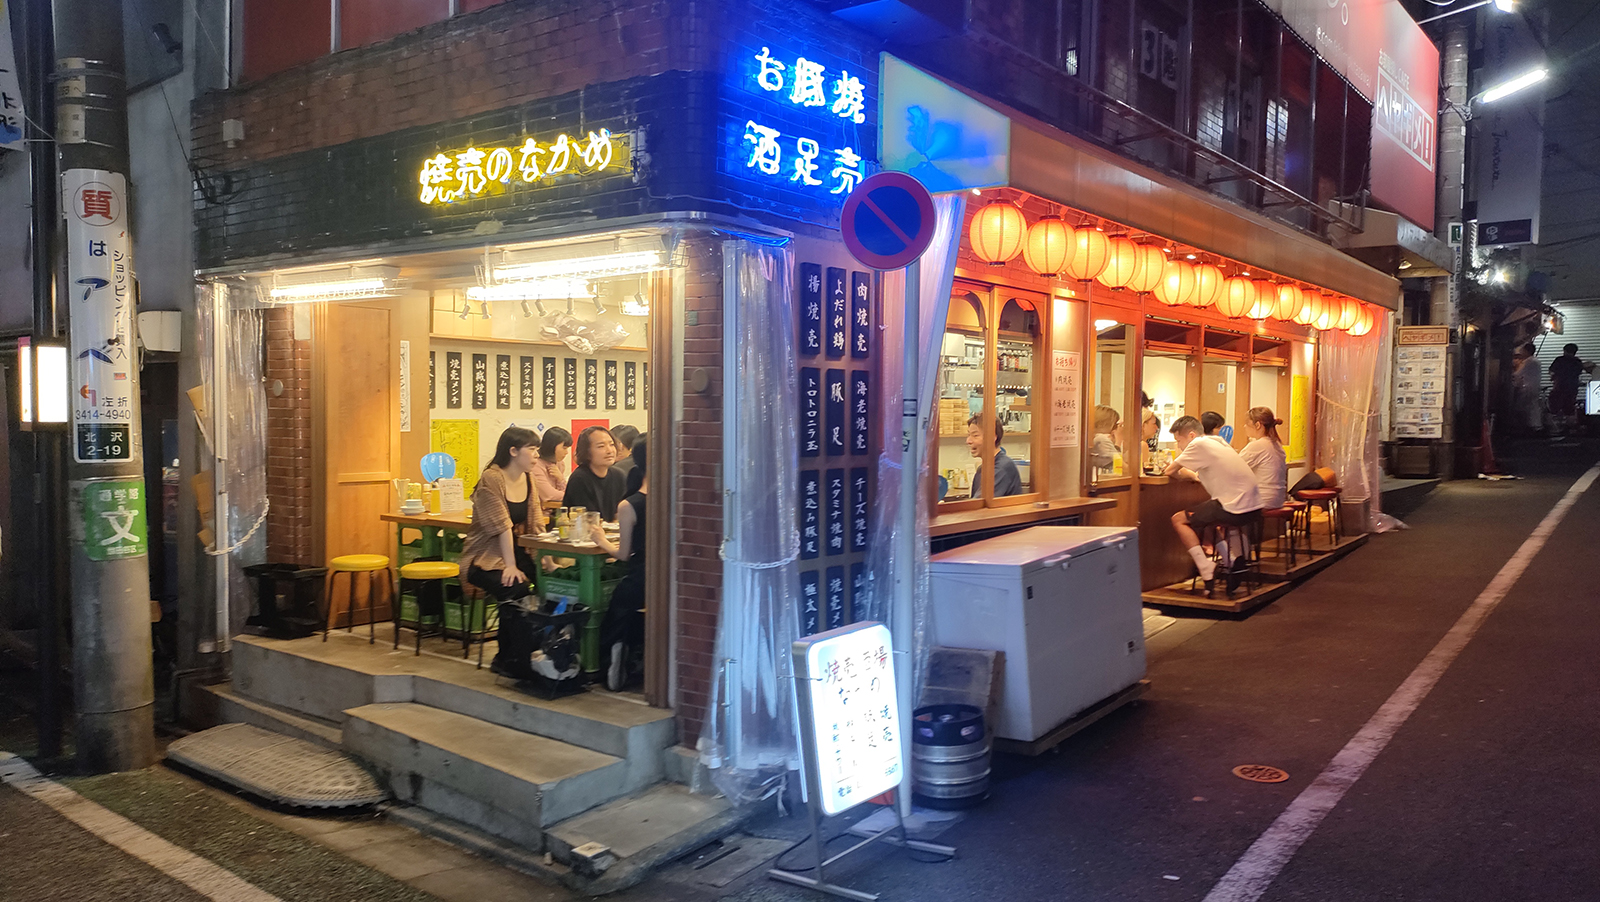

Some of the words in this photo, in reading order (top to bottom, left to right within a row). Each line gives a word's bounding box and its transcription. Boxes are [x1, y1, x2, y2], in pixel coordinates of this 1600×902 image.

[419, 127, 613, 204] 焼売のなかめ
[81, 189, 113, 220] 質
[833, 279, 845, 350] よだれ鶏
[857, 283, 868, 352] 肉焼売
[75, 409, 131, 420] 3414-4940
[84, 431, 123, 442] 北沢
[806, 378, 819, 451] トロトロニラ玉
[831, 382, 844, 447] 豚足
[856, 381, 868, 450] 海老焼売
[86, 445, 122, 456] 2-19
[830, 479, 843, 549] スタミナ焼肉
[855, 477, 866, 547] チーズ焼売
